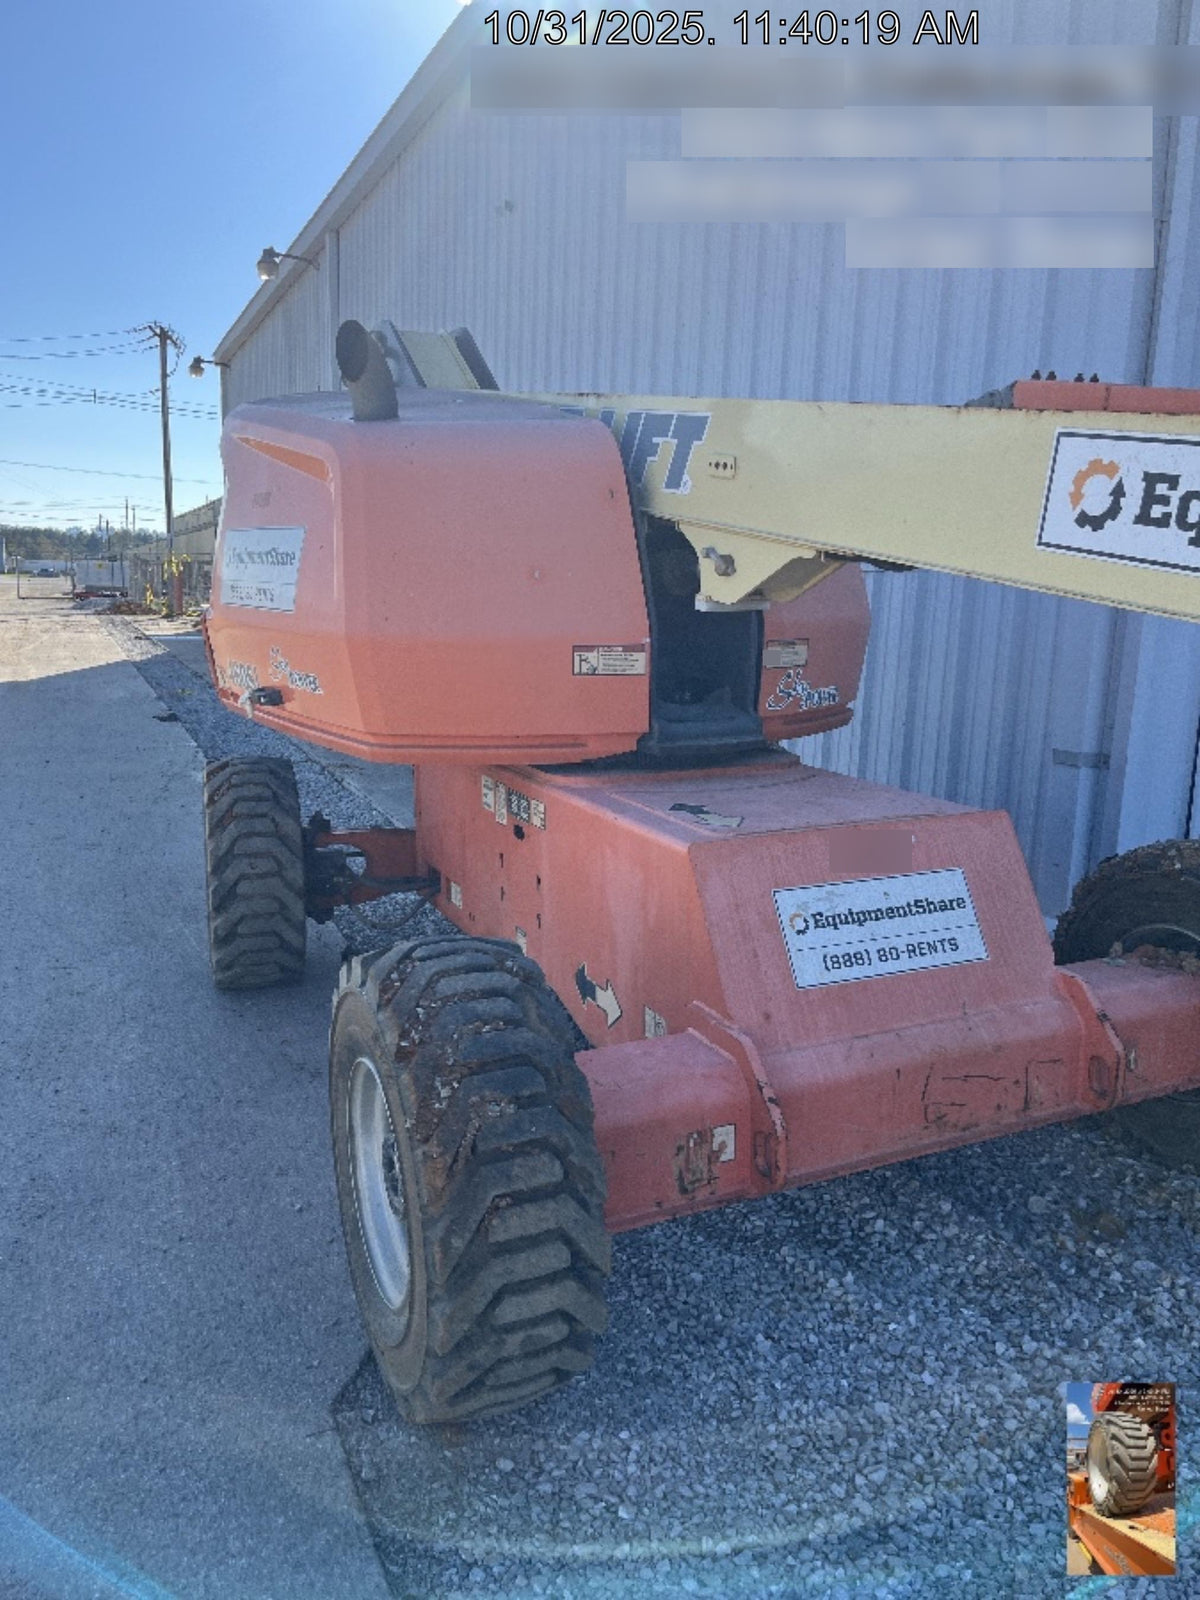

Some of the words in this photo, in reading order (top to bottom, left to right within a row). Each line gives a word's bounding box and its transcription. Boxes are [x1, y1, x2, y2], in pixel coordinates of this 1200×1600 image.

[811, 896, 966, 930] EquipmentShare
[822, 948, 873, 972] (888)
[876, 937, 960, 963] 80-RENTS
